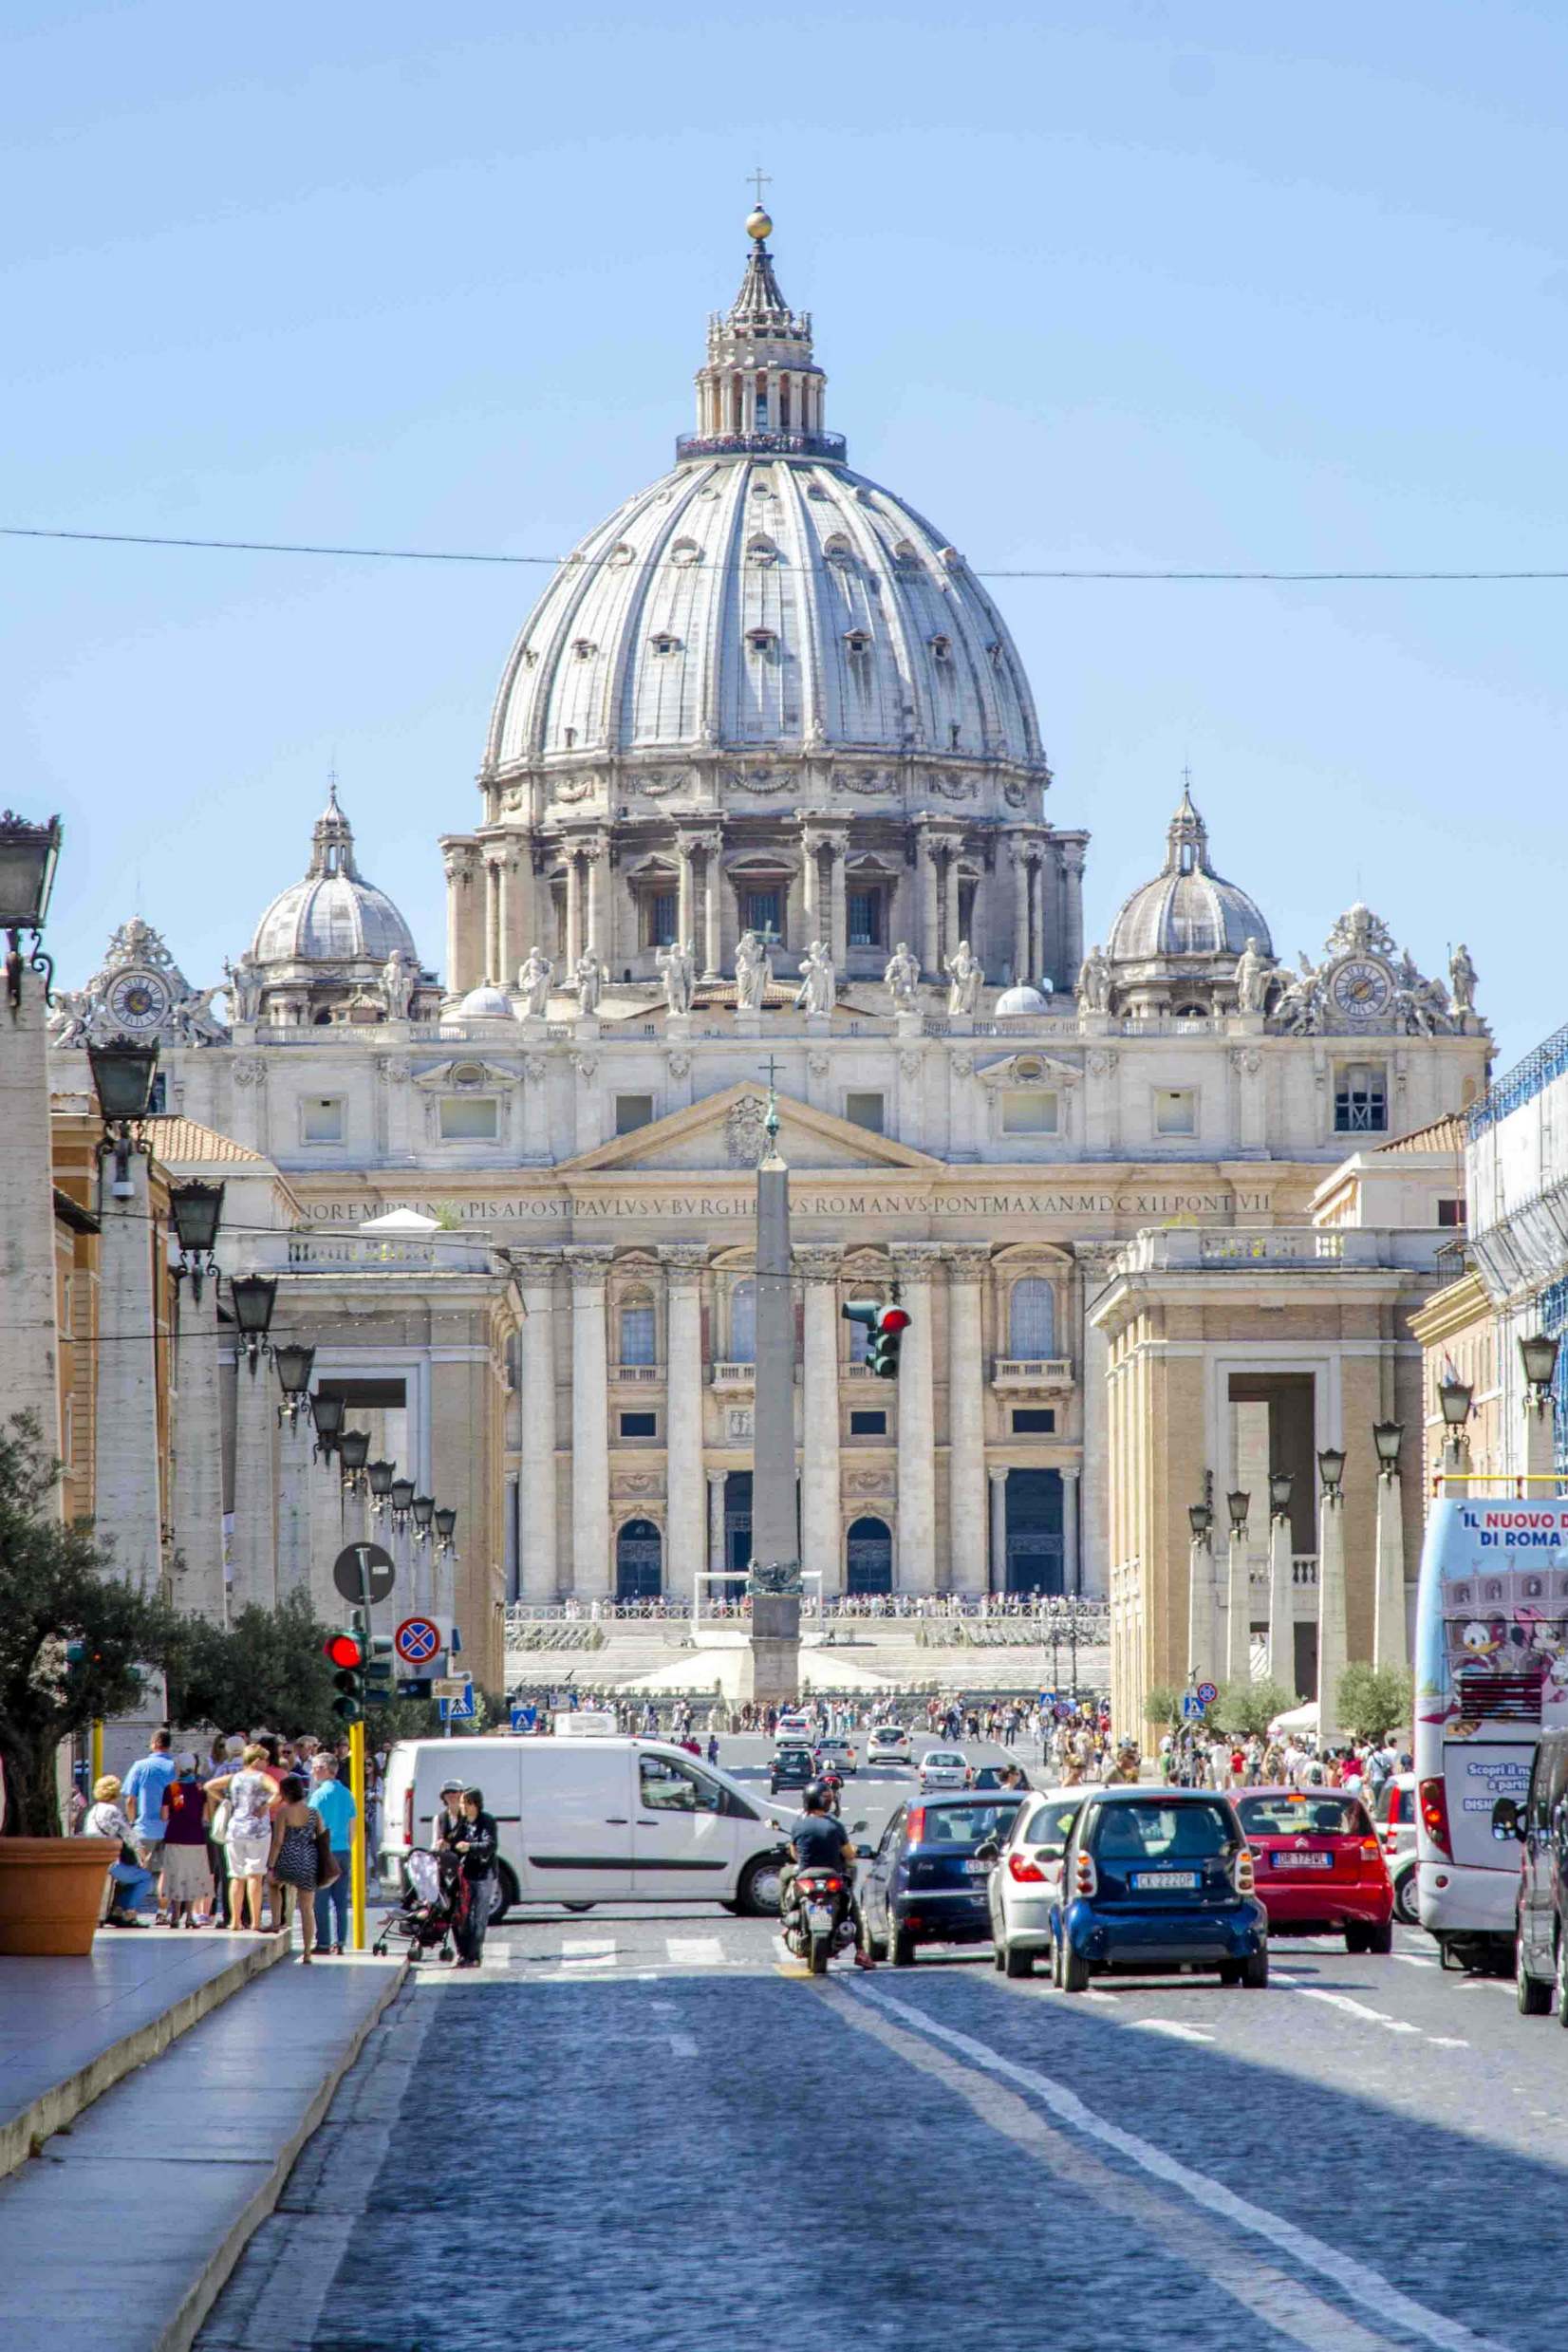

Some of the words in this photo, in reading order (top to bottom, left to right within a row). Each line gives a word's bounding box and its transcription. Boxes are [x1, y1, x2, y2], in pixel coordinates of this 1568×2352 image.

[574, 1198, 648, 1216] PAVLVS
[815, 1196, 927, 1213] ROMANVS
[1239, 1193, 1269, 1210] VII
[1463, 1512, 1480, 1528] IL
[1485, 1512, 1555, 1529] NUOVO
[1480, 1531, 1498, 1546] DI
[1504, 1531, 1561, 1546] ROMA
[1466, 1763, 1505, 1778] Scopri
[1507, 1763, 1517, 1776] il
